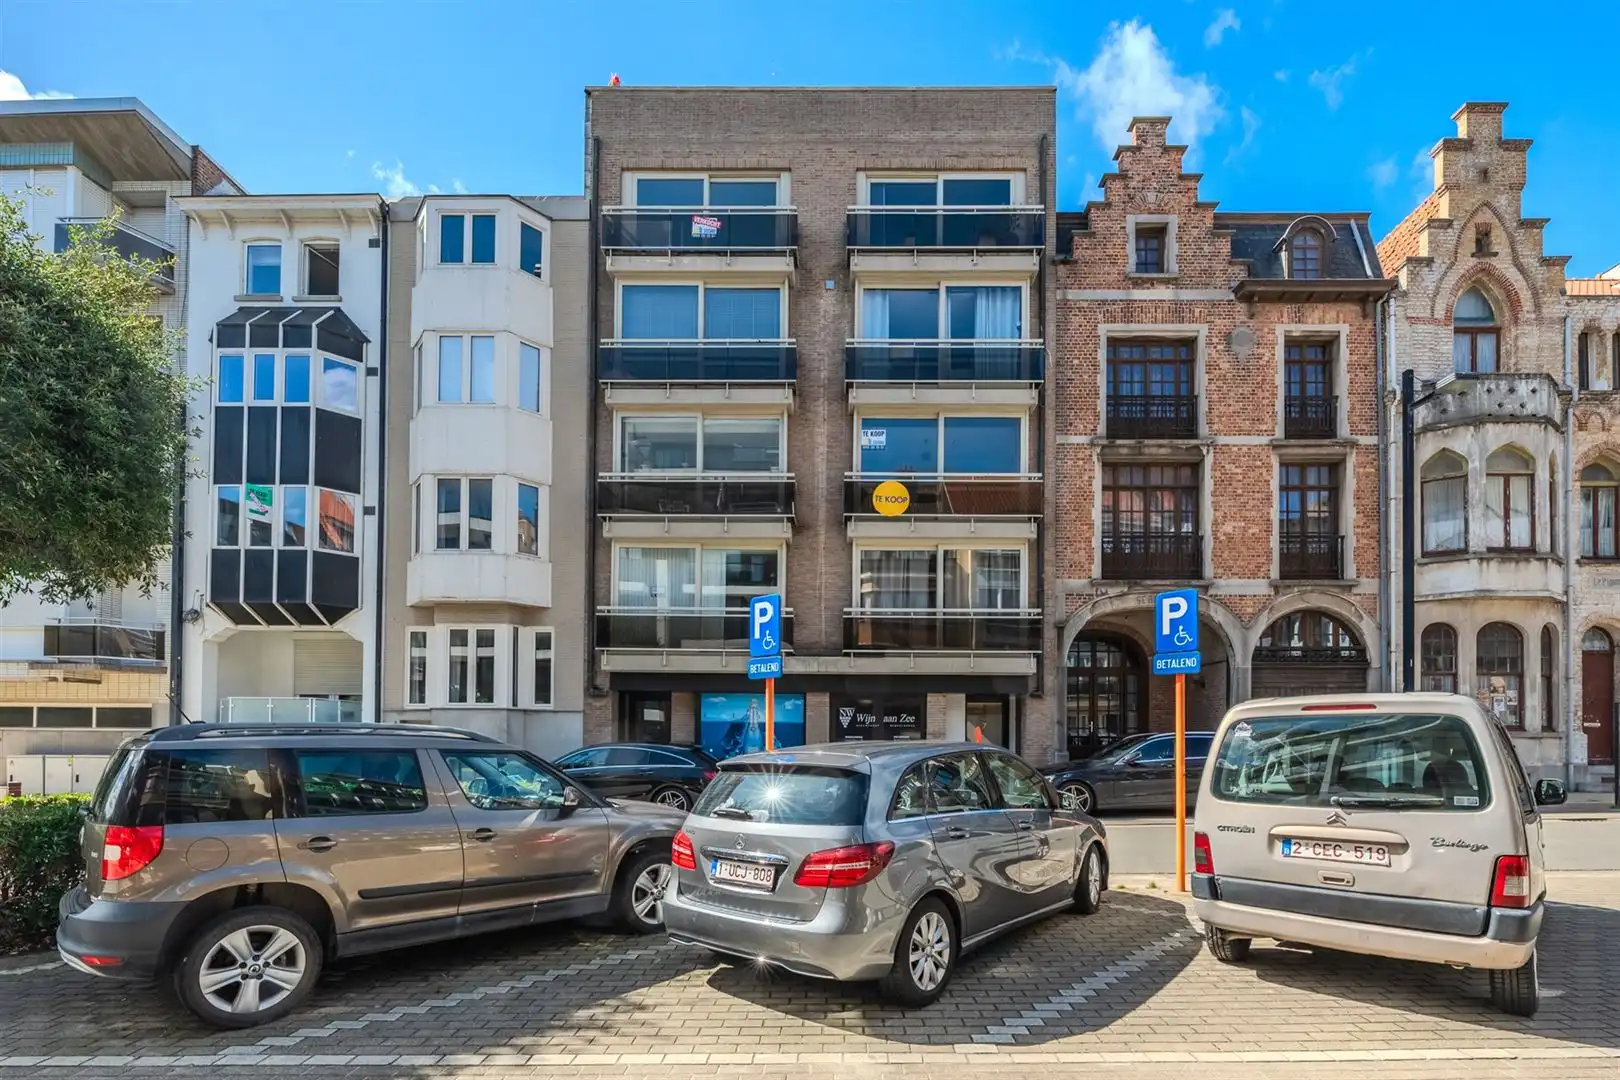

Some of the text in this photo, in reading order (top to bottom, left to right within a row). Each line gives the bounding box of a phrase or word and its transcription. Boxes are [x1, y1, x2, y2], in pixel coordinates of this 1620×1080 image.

[875, 495, 908, 504] TE KOOP
[754, 601, 774, 640] P
[1162, 596, 1188, 636] P
[750, 662, 780, 674] BETALEND
[1156, 657, 1197, 670] BETALEND
[856, 713, 916, 725] Wijn aan Zee
